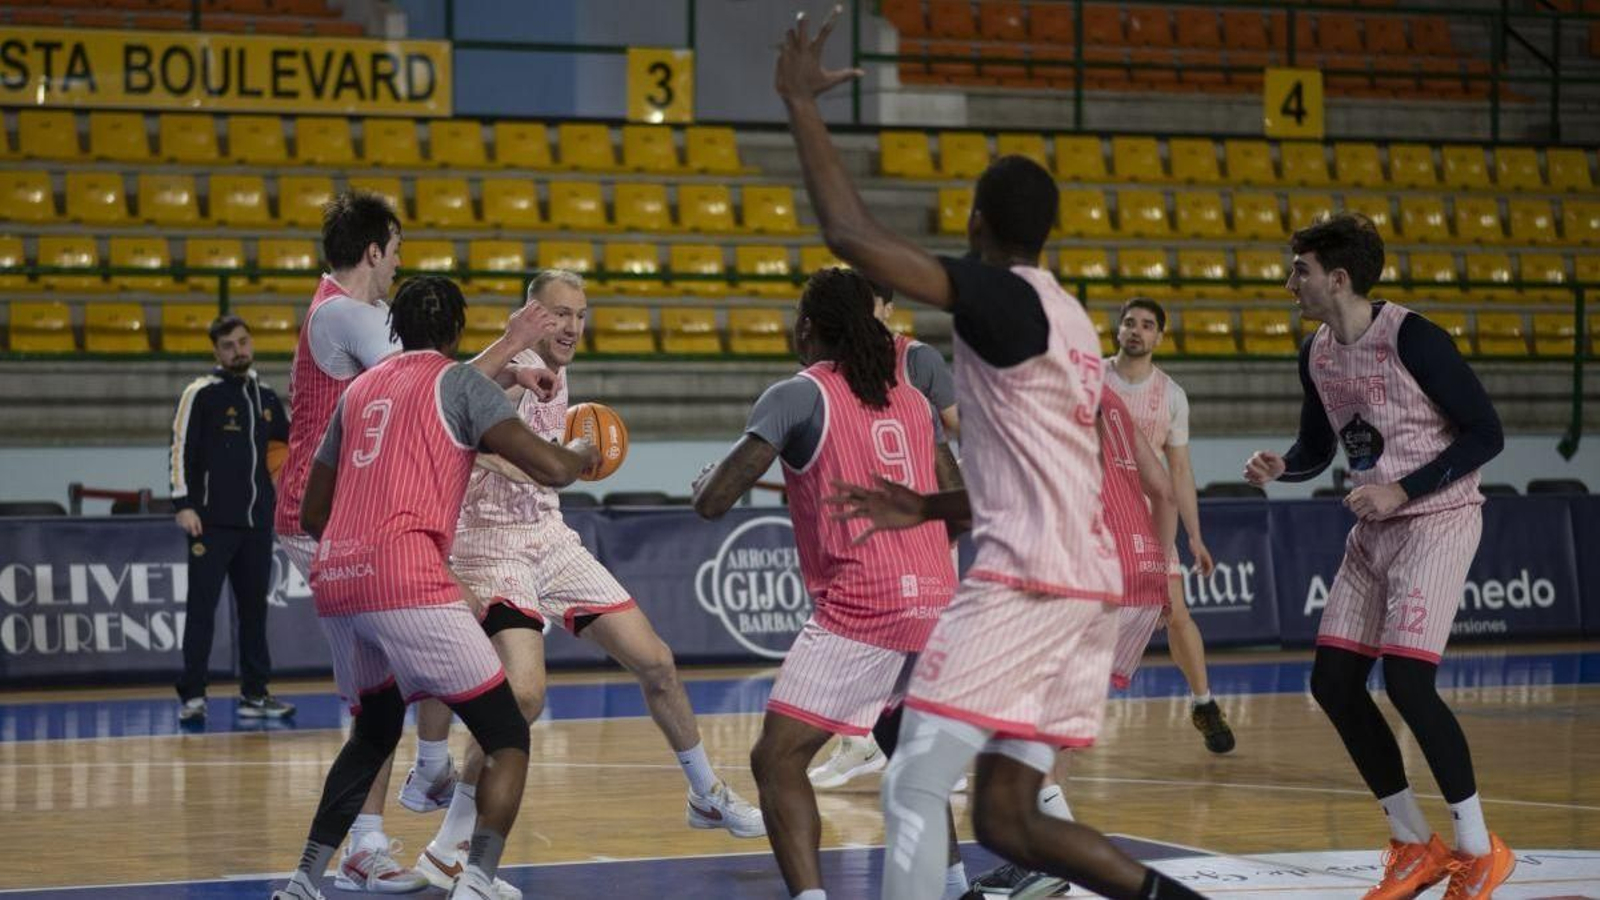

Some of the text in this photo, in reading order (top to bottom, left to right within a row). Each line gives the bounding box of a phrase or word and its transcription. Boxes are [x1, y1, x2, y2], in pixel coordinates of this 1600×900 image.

[124, 42, 436, 102] BOULEVARD
[647, 61, 673, 108] 3
[1281, 79, 1308, 127] 4
[352, 398, 393, 469] 3
[871, 419, 915, 489] 9
[0, 563, 188, 606] CLIVET
[1397, 604, 1428, 635] 12
